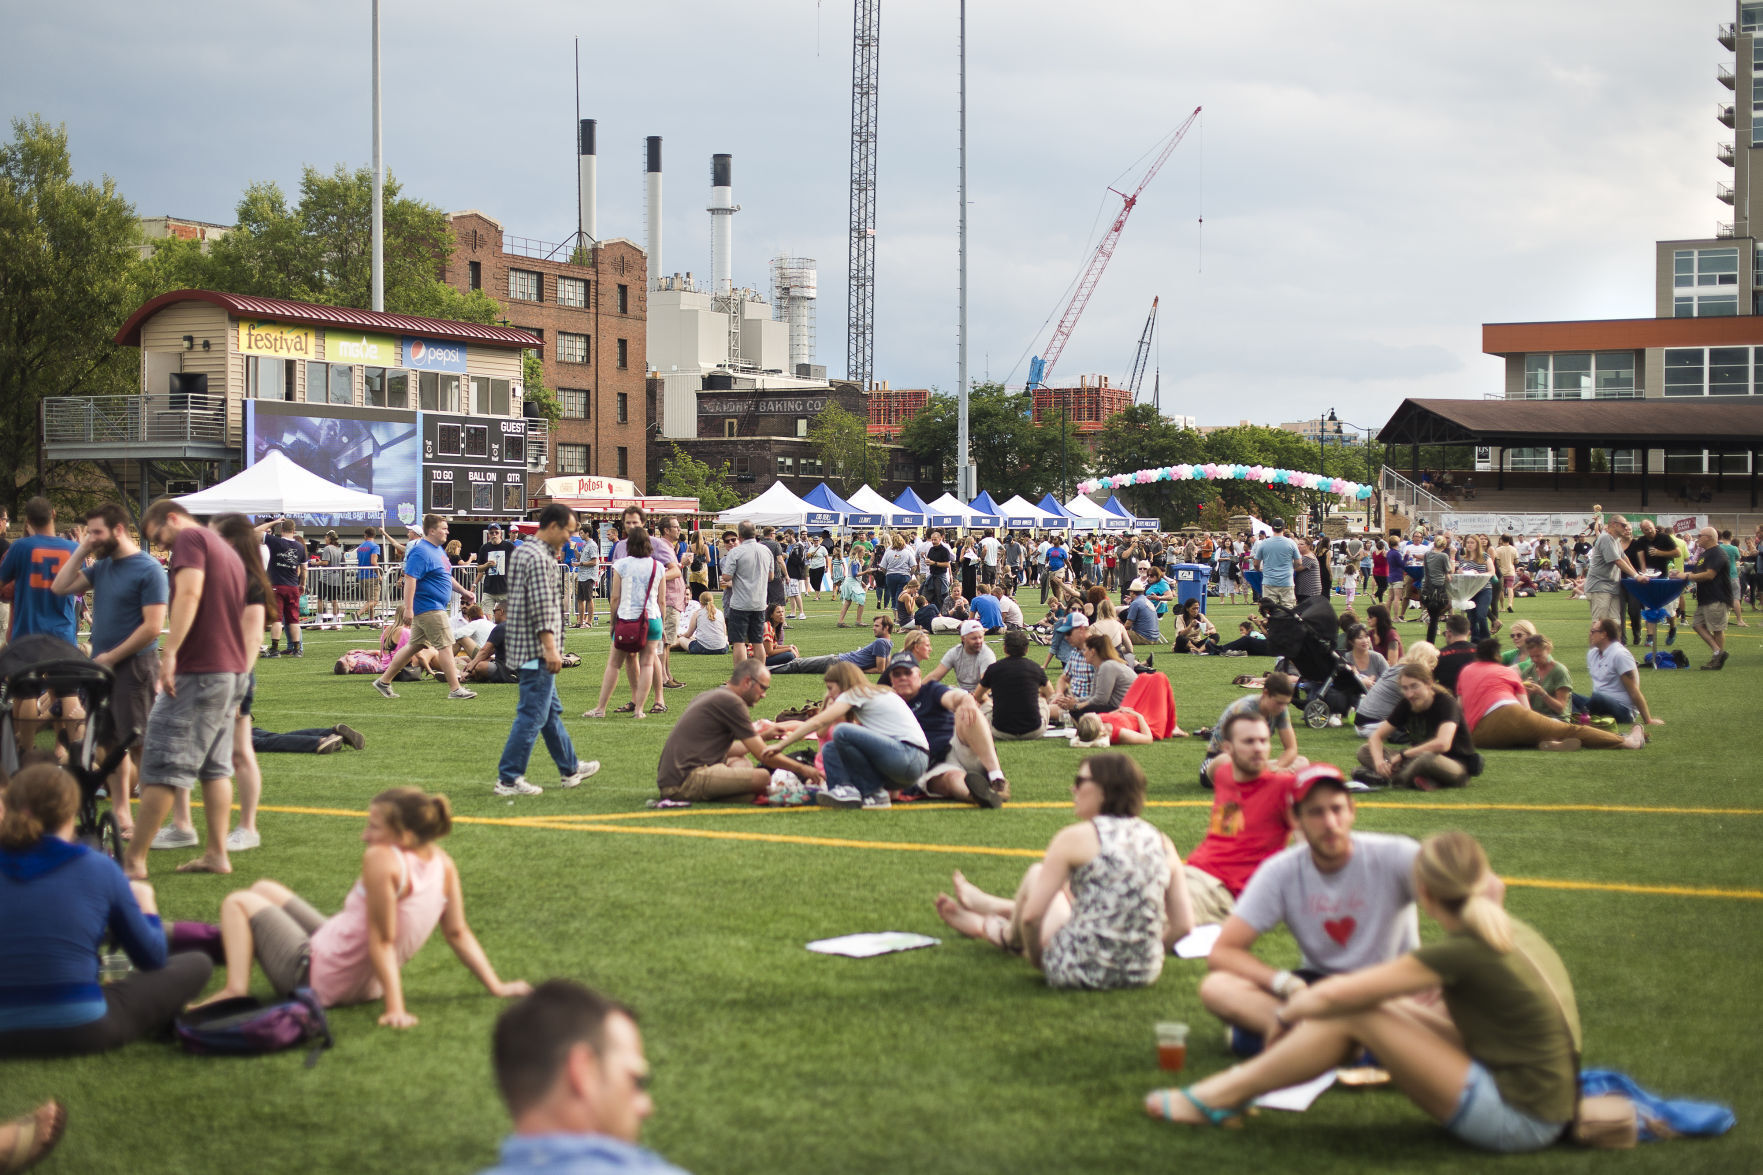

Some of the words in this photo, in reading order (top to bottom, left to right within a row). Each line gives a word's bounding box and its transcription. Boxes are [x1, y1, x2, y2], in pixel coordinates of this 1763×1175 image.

[246, 323, 309, 354] festival
[428, 347, 459, 365] pepsi
[760, 400, 803, 412] BAKING
[501, 421, 525, 433] GUEST
[432, 470, 441, 480] TO
[443, 470, 453, 480] GO
[468, 471, 485, 481] BALL
[486, 472, 497, 482] ON
[506, 473, 520, 483] QTR
[578, 478, 603, 495] Potosi
